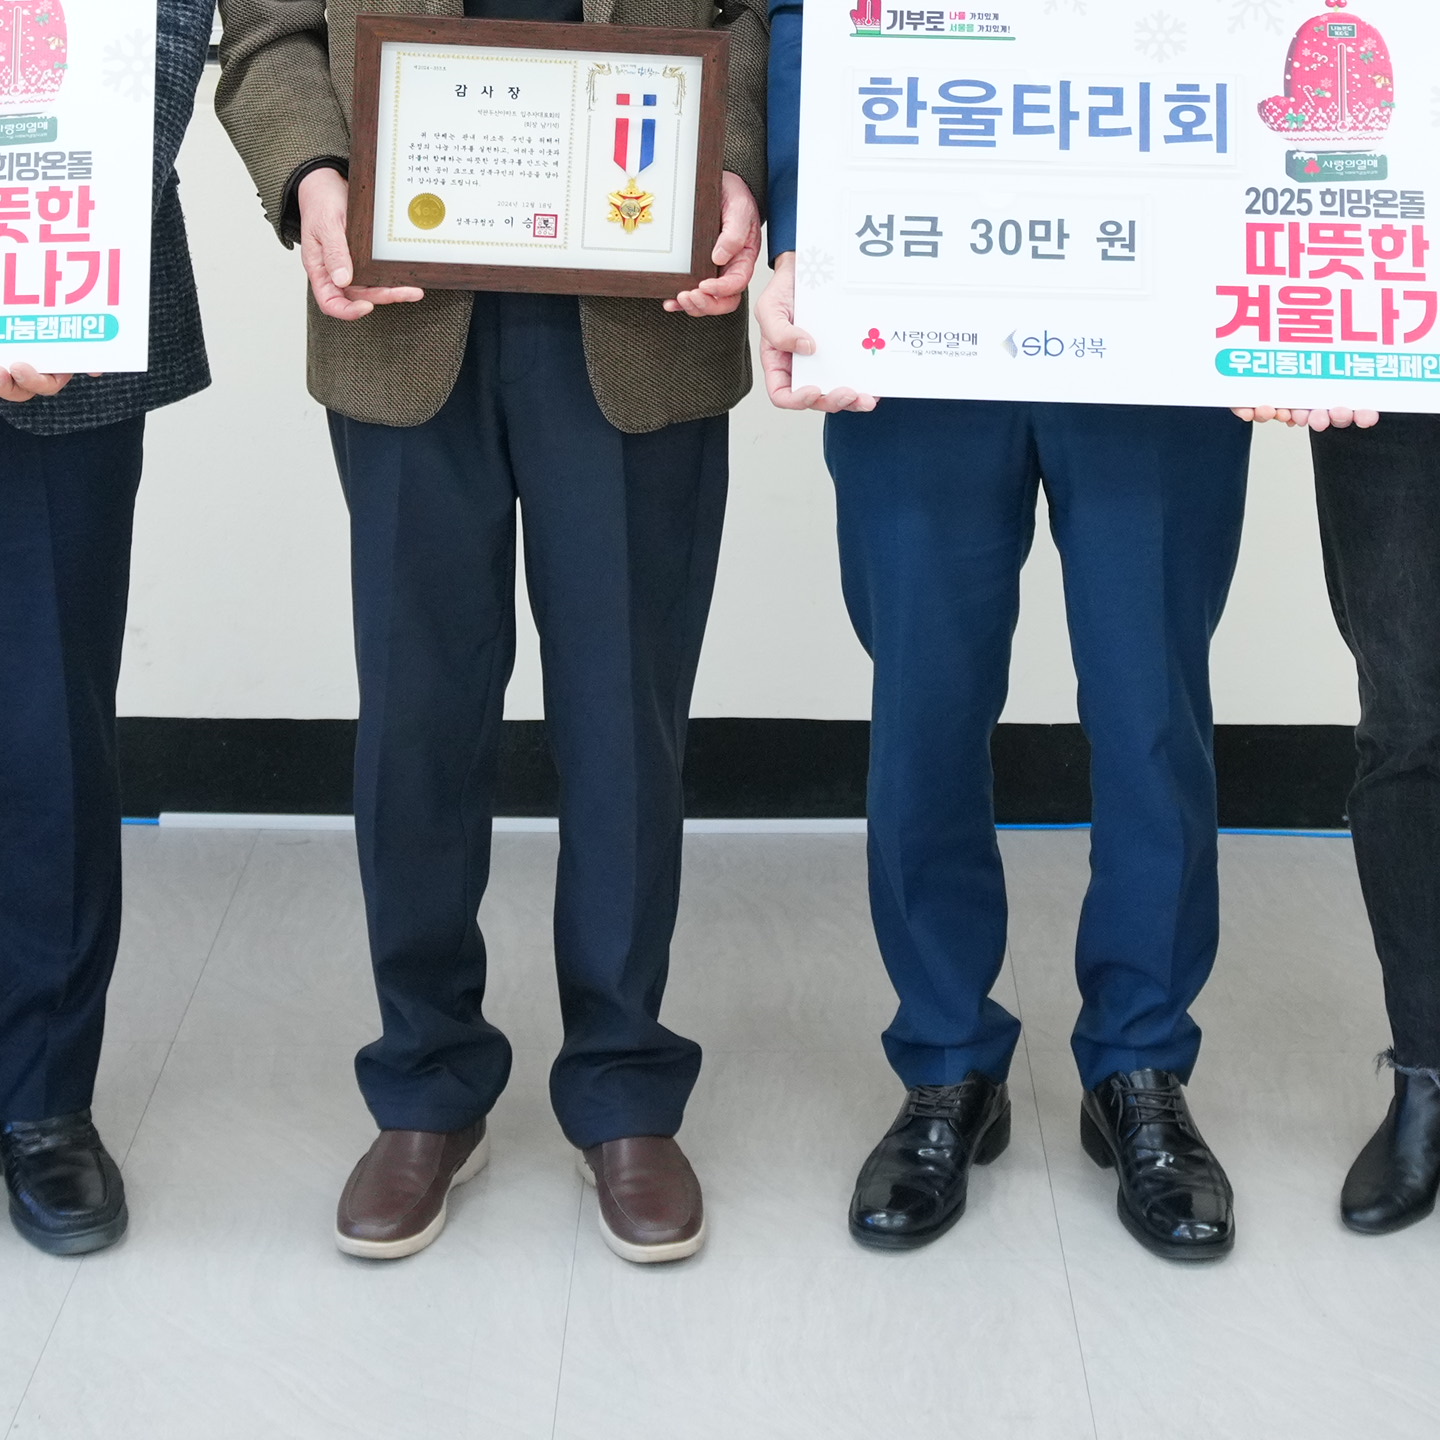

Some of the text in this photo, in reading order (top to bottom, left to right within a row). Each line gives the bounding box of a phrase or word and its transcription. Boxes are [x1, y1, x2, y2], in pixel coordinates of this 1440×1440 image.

[886, 10, 945, 32] 기부로
[859, 77, 1227, 153] 한울타리회
[1321, 159, 1378, 172] 사랑의열매
[1245, 187, 1425, 219] 2025 희망온돌
[856, 215, 1135, 261] 성금 30만 원
[1246, 222, 1429, 281] 따뜻한
[890, 330, 979, 349] 사랑의열매
[1021, 329, 1107, 359] sb 성북
[1229, 349, 1322, 375] 우리동네
